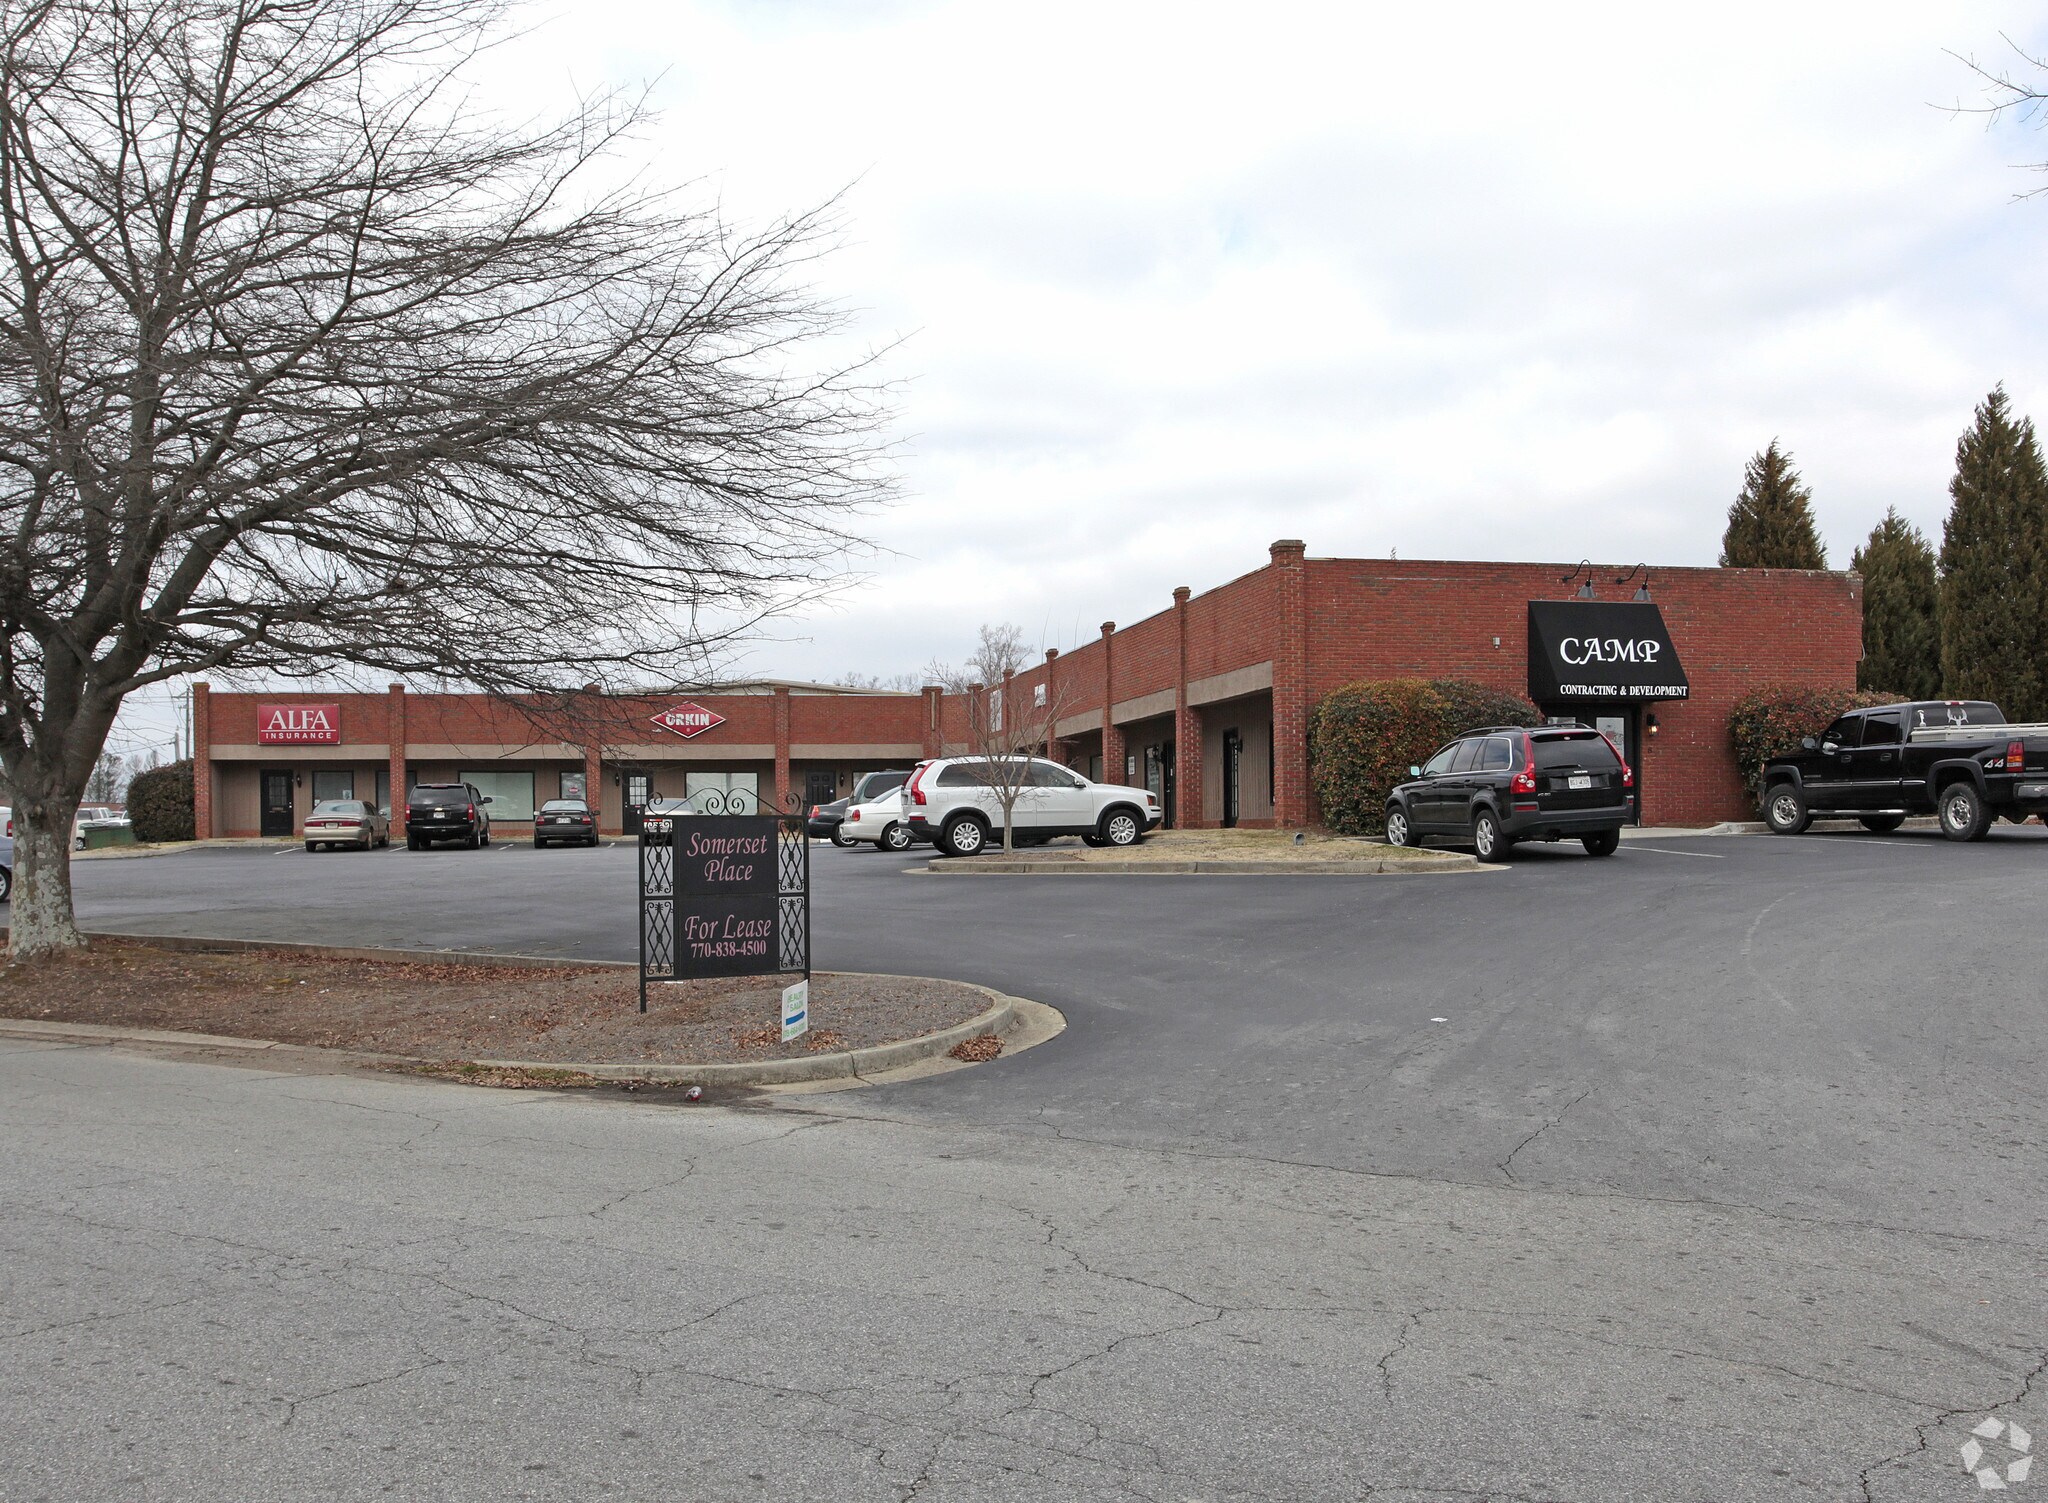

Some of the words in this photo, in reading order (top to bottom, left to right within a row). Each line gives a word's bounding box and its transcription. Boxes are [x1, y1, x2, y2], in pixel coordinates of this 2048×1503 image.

[1560, 637, 1660, 665] CAMP
[1560, 684, 1617, 695] CONTRACTING
[1619, 686, 1627, 696] &
[1629, 685, 1688, 697] DEVELOPMENT
[267, 710, 331, 730] ALFA
[665, 713, 710, 726] ORKIN
[686, 832, 768, 857] Somerset
[704, 856, 753, 882] Place
[684, 915, 719, 940] For
[722, 914, 772, 939] Lease
[690, 939, 767, 958] 770-838-4500
